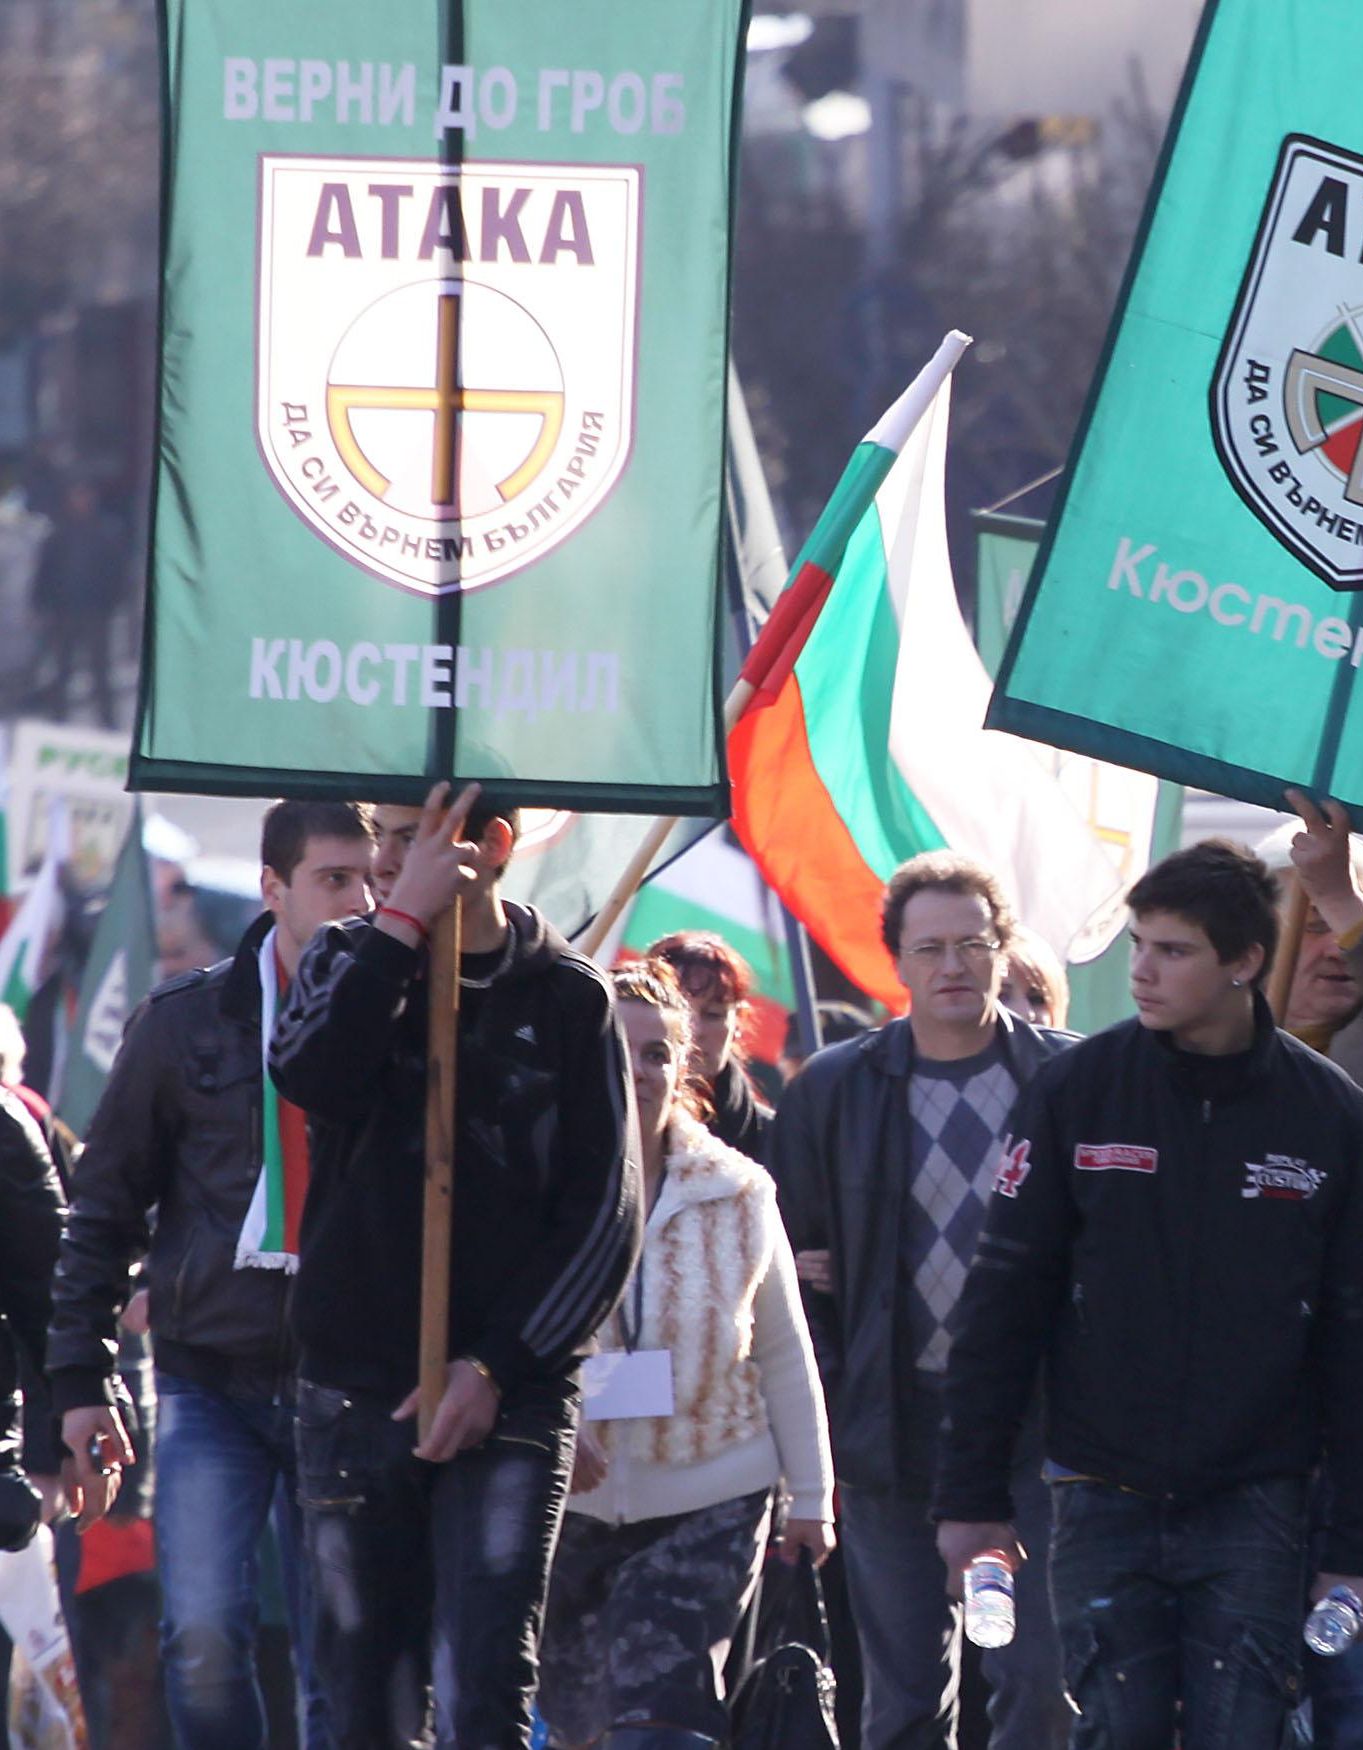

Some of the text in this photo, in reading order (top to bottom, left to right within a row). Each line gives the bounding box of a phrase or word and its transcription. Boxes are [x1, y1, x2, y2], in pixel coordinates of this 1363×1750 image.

[224, 57, 687, 142] ВЕРНИ ДО ГРОБ
[306, 182, 595, 266] АТАКА
[1244, 359, 1270, 405] ДА
[1251, 414, 1279, 457] СИ
[281, 402, 605, 562] ДА СИ ВЪРНЕМ БЪЛГАРИЯ
[249, 637, 620, 723] КЮСТЕНДИЛ
